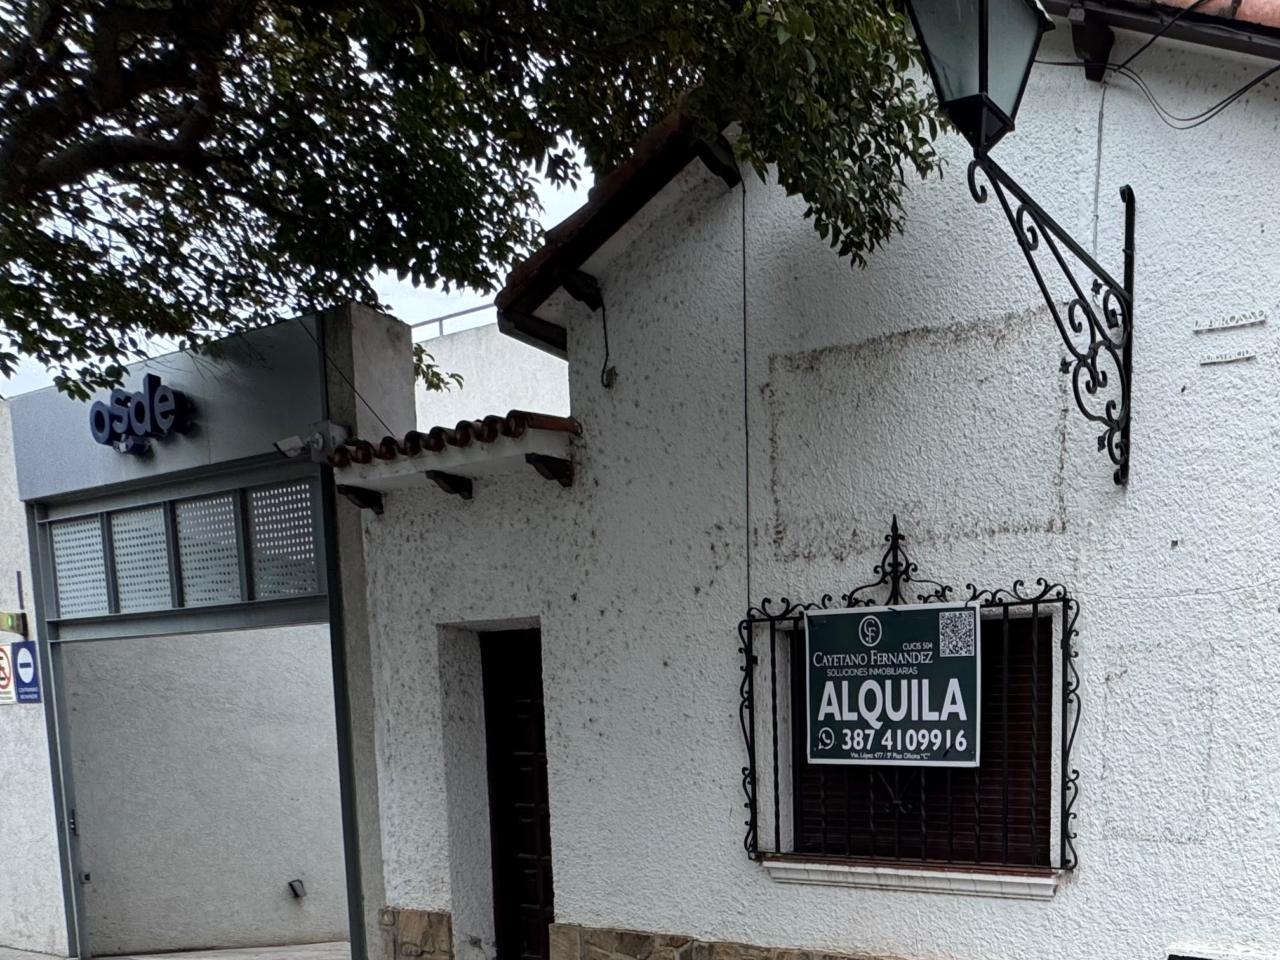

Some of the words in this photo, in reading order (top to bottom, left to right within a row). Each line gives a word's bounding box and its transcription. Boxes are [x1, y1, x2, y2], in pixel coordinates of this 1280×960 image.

[89, 373, 178, 446] osde
[813, 652, 868, 667] CAYETANO
[870, 650, 933, 665] FERNANDEZ
[827, 668, 868, 676] SOLUCIONES
[869, 667, 918, 675] INMOBILIARIAS
[817, 678, 967, 729] ALQUILA
[841, 729, 875, 751] 387
[881, 729, 967, 752] 4109916
